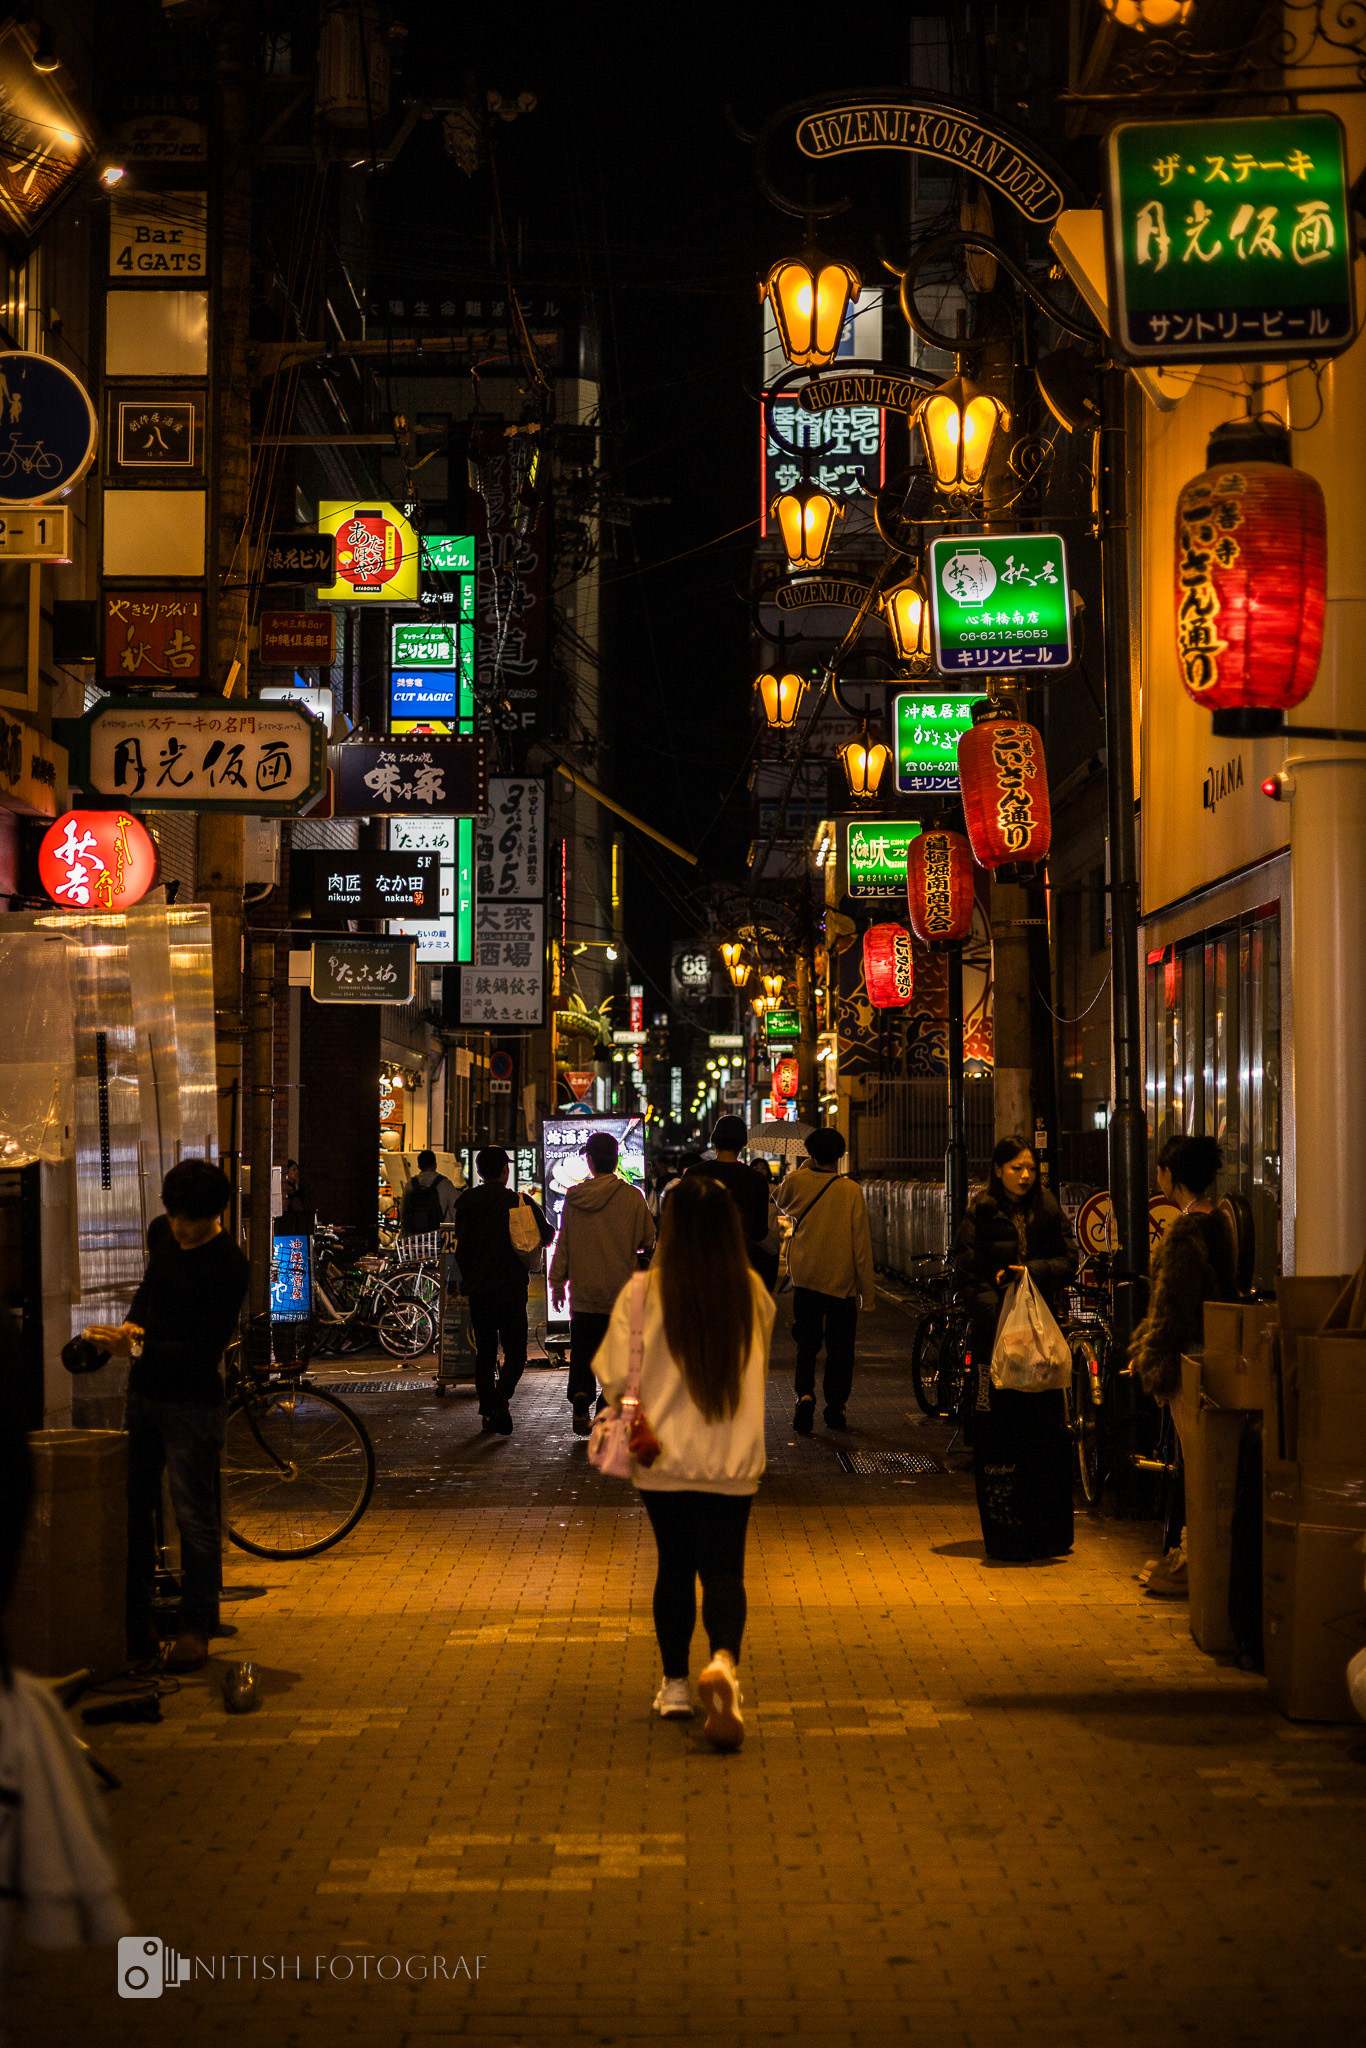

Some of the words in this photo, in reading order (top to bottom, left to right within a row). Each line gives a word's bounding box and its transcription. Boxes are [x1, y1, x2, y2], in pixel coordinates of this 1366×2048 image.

[1152, 147, 1315, 186] ザ・ステーキ
[135, 226, 183, 244] Bar
[1136, 200, 1335, 273] 月光仮面
[1150, 309, 1330, 341] サントリービール
[142, 426, 169, 450] 八
[268, 548, 329, 569] 浪花ビル
[1000, 555, 1059, 587] 秋吉
[1178, 485, 1228, 691] こいさん通り
[109, 600, 198, 623] やきとりの名門
[965, 610, 1040, 626] 心斎橋南店
[265, 633, 328, 648] 沖縄倶楽部
[960, 629, 1048, 642] 06-6212-5053
[121, 625, 197, 675] 秋吉
[958, 647, 1053, 667] キリンビール
[394, 693, 416, 701] CUT
[417, 693, 453, 701] MAGIC
[147, 717, 256, 734] ステーキの名門
[377, 751, 396, 763] 大阪
[1017, 725, 1037, 778] 法善寺
[113, 737, 292, 796] 月光仮面
[363, 763, 446, 805] 味乃家
[911, 777, 961, 789] キリンビ
[992, 727, 1038, 852] こいさん通り
[54, 820, 105, 905] 秋吉
[417, 857, 432, 868] 5F
[328, 873, 361, 892] 肉匠
[376, 874, 424, 892] なか田
[924, 835, 955, 934] 道頓堀南商店会
[328, 893, 361, 904] nikusyo
[385, 894, 413, 902] nakata
[477, 906, 532, 930] 大衆
[417, 940, 450, 949] ルテミス
[894, 934, 912, 997] こいさん通り
[475, 977, 540, 996] 鉄鍋餃子
[483, 1007, 540, 1021] 焼きそば
[545, 1150, 580, 1159] Steamed
